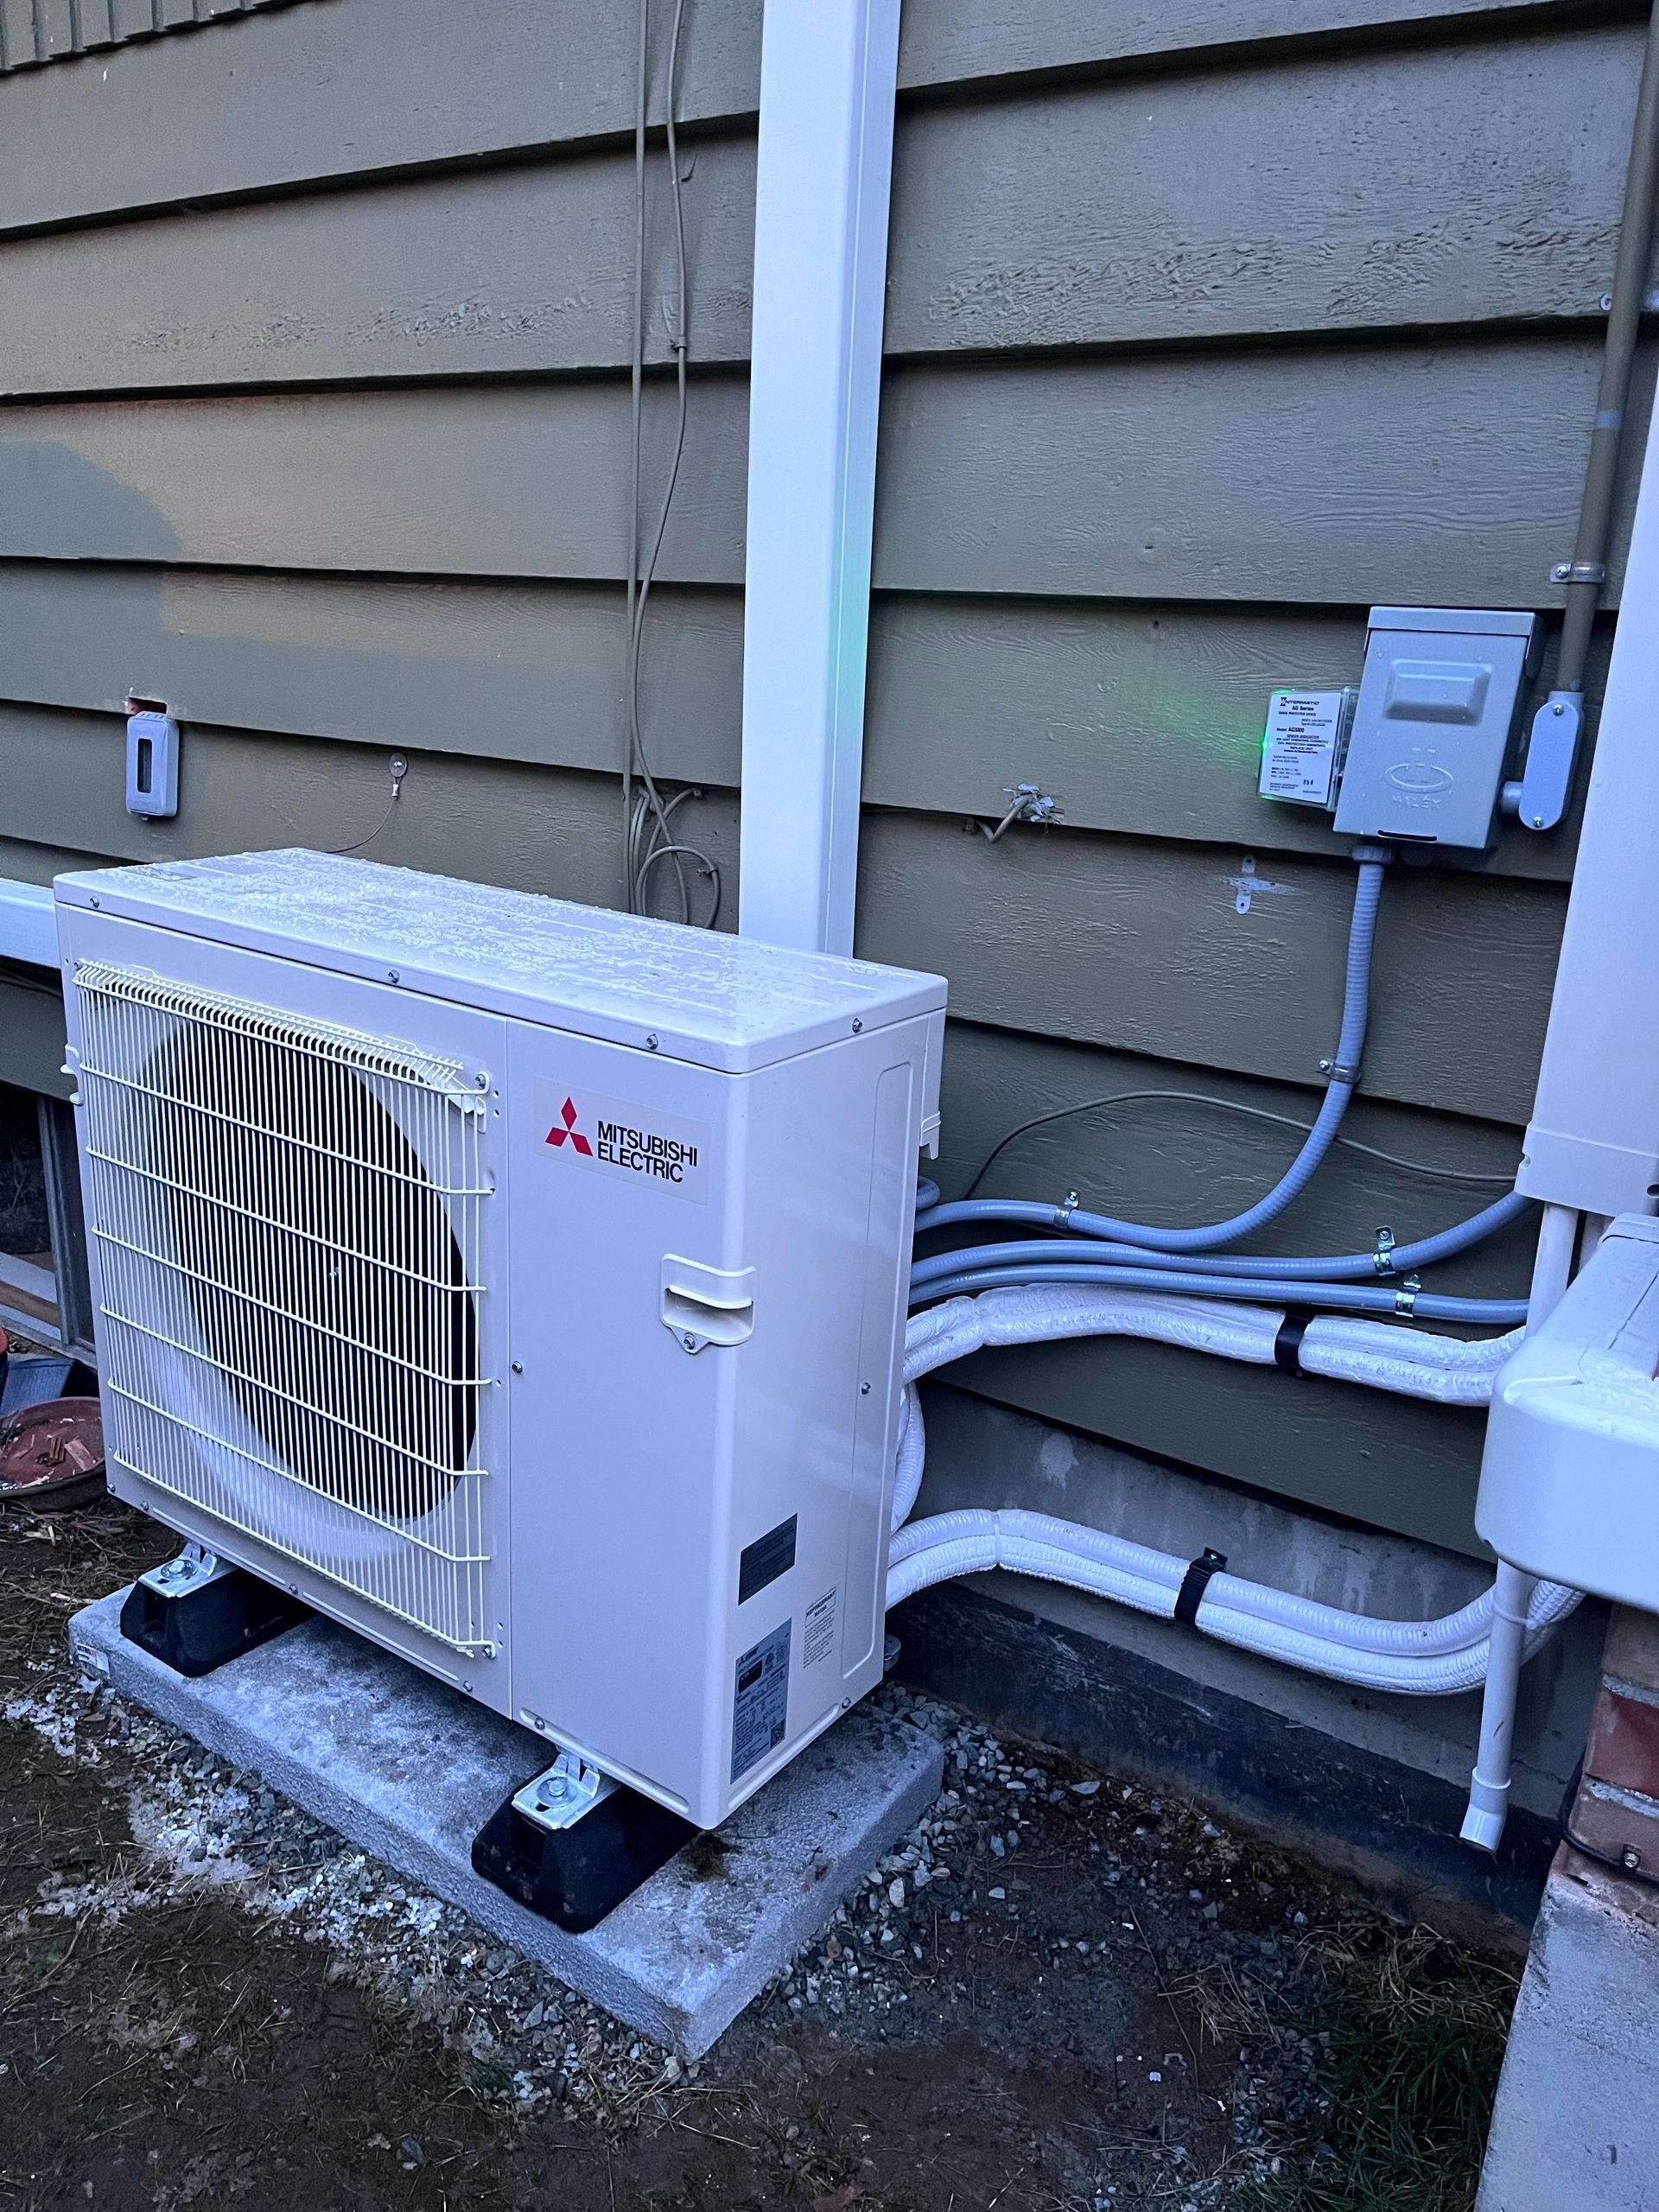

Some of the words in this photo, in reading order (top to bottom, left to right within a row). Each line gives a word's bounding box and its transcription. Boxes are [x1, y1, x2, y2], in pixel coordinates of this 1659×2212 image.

[1280, 696, 1320, 707] INTERMATIC
[598, 1121, 697, 1166] MITSUBISHI
[598, 1141, 683, 1183] ELECTRIC
